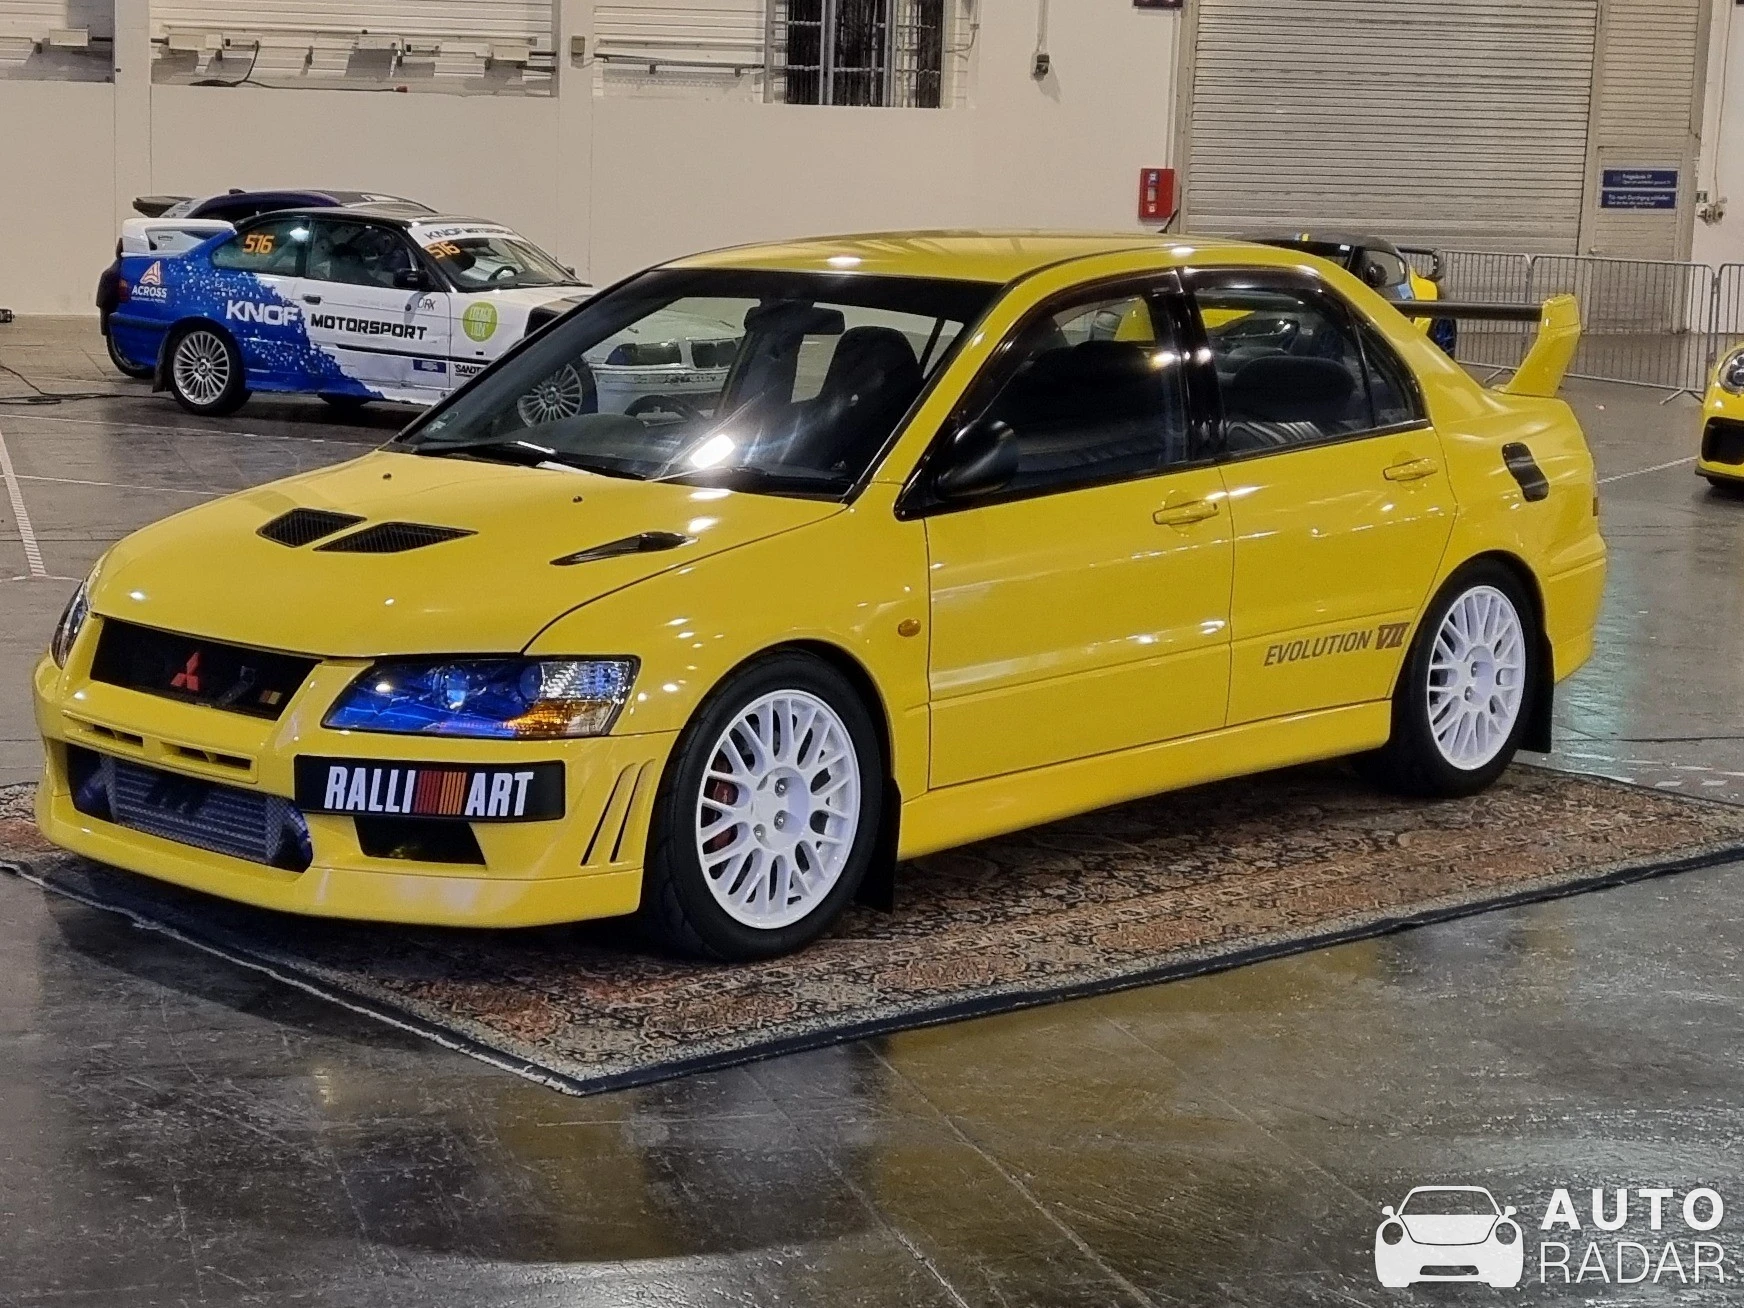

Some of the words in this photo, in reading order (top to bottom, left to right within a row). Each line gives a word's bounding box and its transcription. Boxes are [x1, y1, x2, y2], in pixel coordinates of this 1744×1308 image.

[242, 234, 275, 254] 516
[426, 241, 461, 259] 516
[131, 285, 168, 298] ACROSS
[226, 300, 299, 326] KNOF
[310, 313, 428, 340] MOTORSPORT
[1264, 629, 1374, 667] EVOLUTION
[1375, 622, 1411, 650] VII
